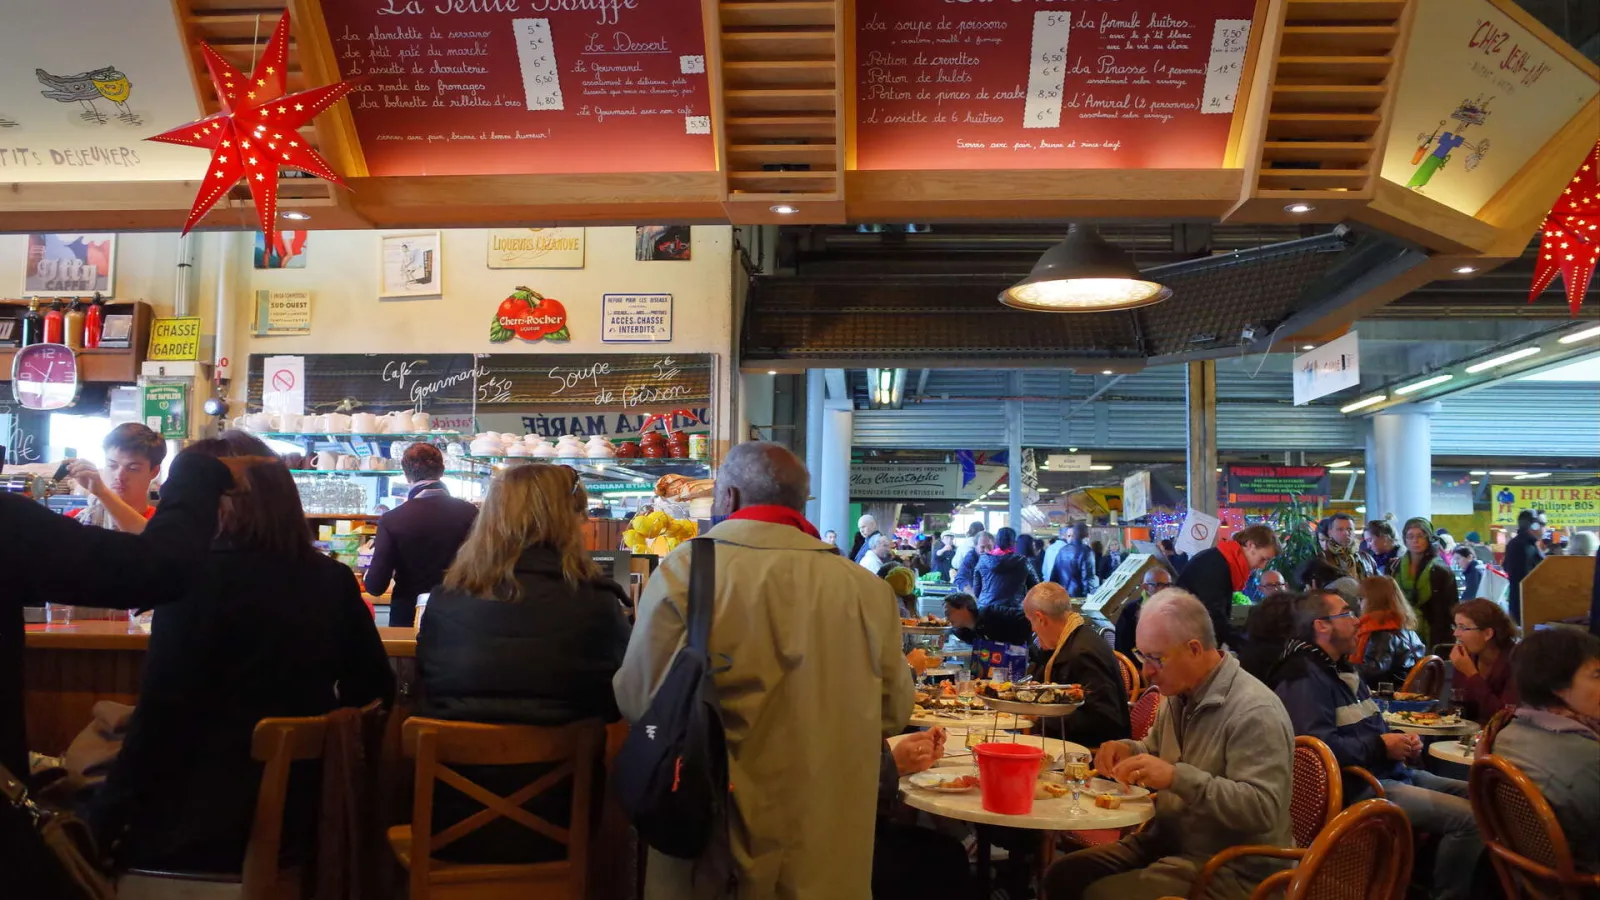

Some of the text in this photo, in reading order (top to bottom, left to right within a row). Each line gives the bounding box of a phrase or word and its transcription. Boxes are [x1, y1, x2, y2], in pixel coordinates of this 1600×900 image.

[894, 20, 932, 36] soupe
[937, 15, 952, 30] de
[957, 19, 1007, 35] poissons
[1100, 11, 1141, 34] formule
[369, 27, 422, 46] planchette
[430, 27, 443, 39] de
[585, 31, 668, 52] Le Dessert
[368, 45, 391, 63] petit
[428, 45, 442, 57] du
[447, 43, 488, 58] marché
[866, 50, 981, 67] Portion de crevettes
[412, 62, 424, 75] de
[429, 60, 489, 75] charcuterie
[1098, 55, 1147, 75] Pinasse
[868, 67, 973, 84] Portion de bulots
[378, 79, 409, 92] ronde
[415, 79, 430, 92] des
[439, 78, 486, 98] fromages
[868, 84, 912, 101] Portion
[918, 87, 932, 101] de
[935, 90, 970, 106] pinces
[975, 87, 990, 101] de
[433, 95, 445, 108] de
[449, 93, 491, 108] rillettes
[934, 111, 947, 124] de
[951, 111, 959, 124] 6
[963, 111, 1005, 124] huîtres
[271, 301, 308, 310] SUD-OUEST
[611, 316, 664, 325] ACCÈS CHASSE
[156, 323, 196, 338] CHASSE
[619, 325, 655, 334] INTERDITS
[41, 348, 56, 359] 12
[153, 341, 194, 356] GARDÉE
[382, 360, 424, 391] Café
[548, 361, 611, 394] Soupe
[410, 368, 491, 414] Gourmand
[595, 384, 691, 409] de Poisson
[875, 471, 940, 486] Christophe
[1520, 488, 1600, 501] HUITRES
[1531, 501, 1594, 513] Philippe BOS
